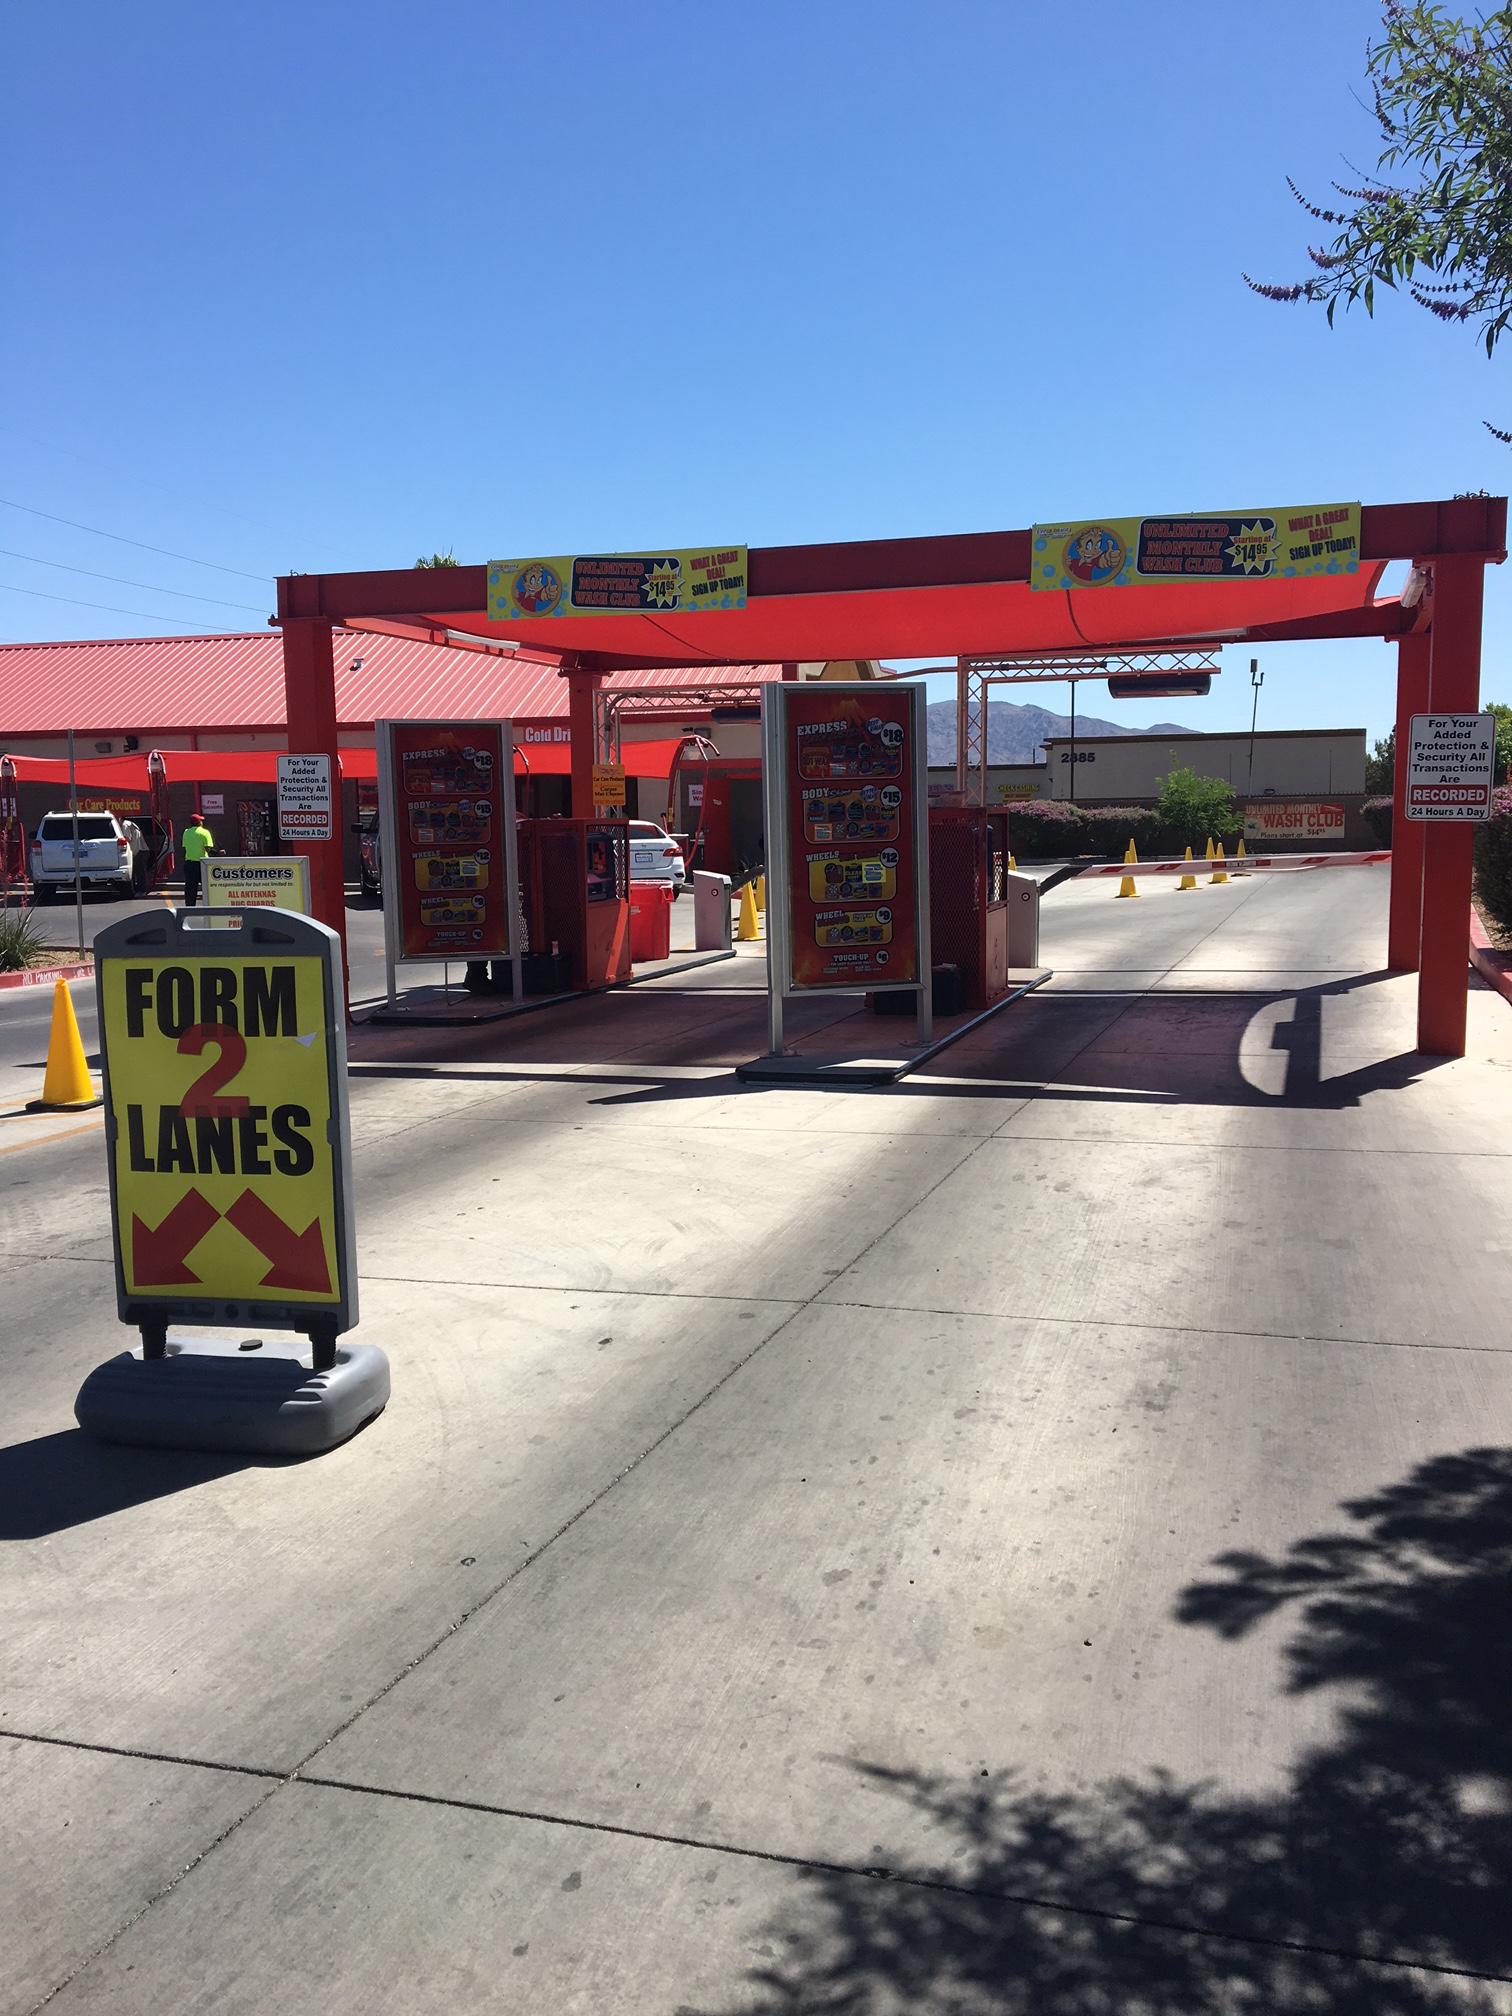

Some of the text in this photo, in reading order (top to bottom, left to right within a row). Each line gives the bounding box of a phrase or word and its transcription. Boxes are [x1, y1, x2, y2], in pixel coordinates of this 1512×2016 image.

[1288, 515, 1314, 532] WHAT
[1323, 508, 1349, 525] GREAT
[1143, 523, 1229, 538] UNLIMITED
[1233, 536, 1263, 544] Starting
[1146, 541, 1222, 555] MONTHLY
[1289, 536, 1356, 561] SIGN UP TODAY!
[575, 562, 644, 576] UNLIMITED
[1142, 556, 1223, 573] WASH CLUB
[579, 577, 639, 591] MONTHLY
[691, 575, 744, 596] SIGN UP TODAY!
[575, 591, 641, 606] WASH CLUB
[1428, 720, 1478, 728] For Your
[525, 727, 551, 742] Cold
[797, 721, 903, 743] EXPRESS $18
[1434, 731, 1471, 739] Added
[1414, 742, 1489, 750] Protection &
[402, 749, 446, 761] EXPRESS
[1061, 752, 1095, 763] 2885
[1417, 753, 1485, 763] Security All
[1412, 764, 1489, 772] Transactions
[1440, 775, 1461, 783] Are
[802, 788, 829, 800] BODY
[883, 791, 900, 803] $15
[1413, 789, 1485, 801] RECORDED
[85, 798, 105, 810] Care
[105, 798, 141, 810] Products
[408, 801, 432, 810] BODY
[1245, 803, 1321, 814] UNLIMITED MONTHLY
[282, 814, 327, 824] RECORDED
[1467, 808, 1485, 818] Day
[1263, 814, 1344, 828] WASH CLUB
[317, 829, 328, 837] Day
[805, 850, 840, 862] WHEELS
[883, 852, 898, 863] $12
[212, 866, 292, 879] Customers
[228, 890, 277, 898] ALL ANTENNAS
[833, 954, 869, 962] TOUCH-UP
[22, 972, 32, 986] NO
[125, 966, 297, 1039] FORM
[176, 1022, 251, 1118] 2
[126, 1103, 315, 1176] LANES
